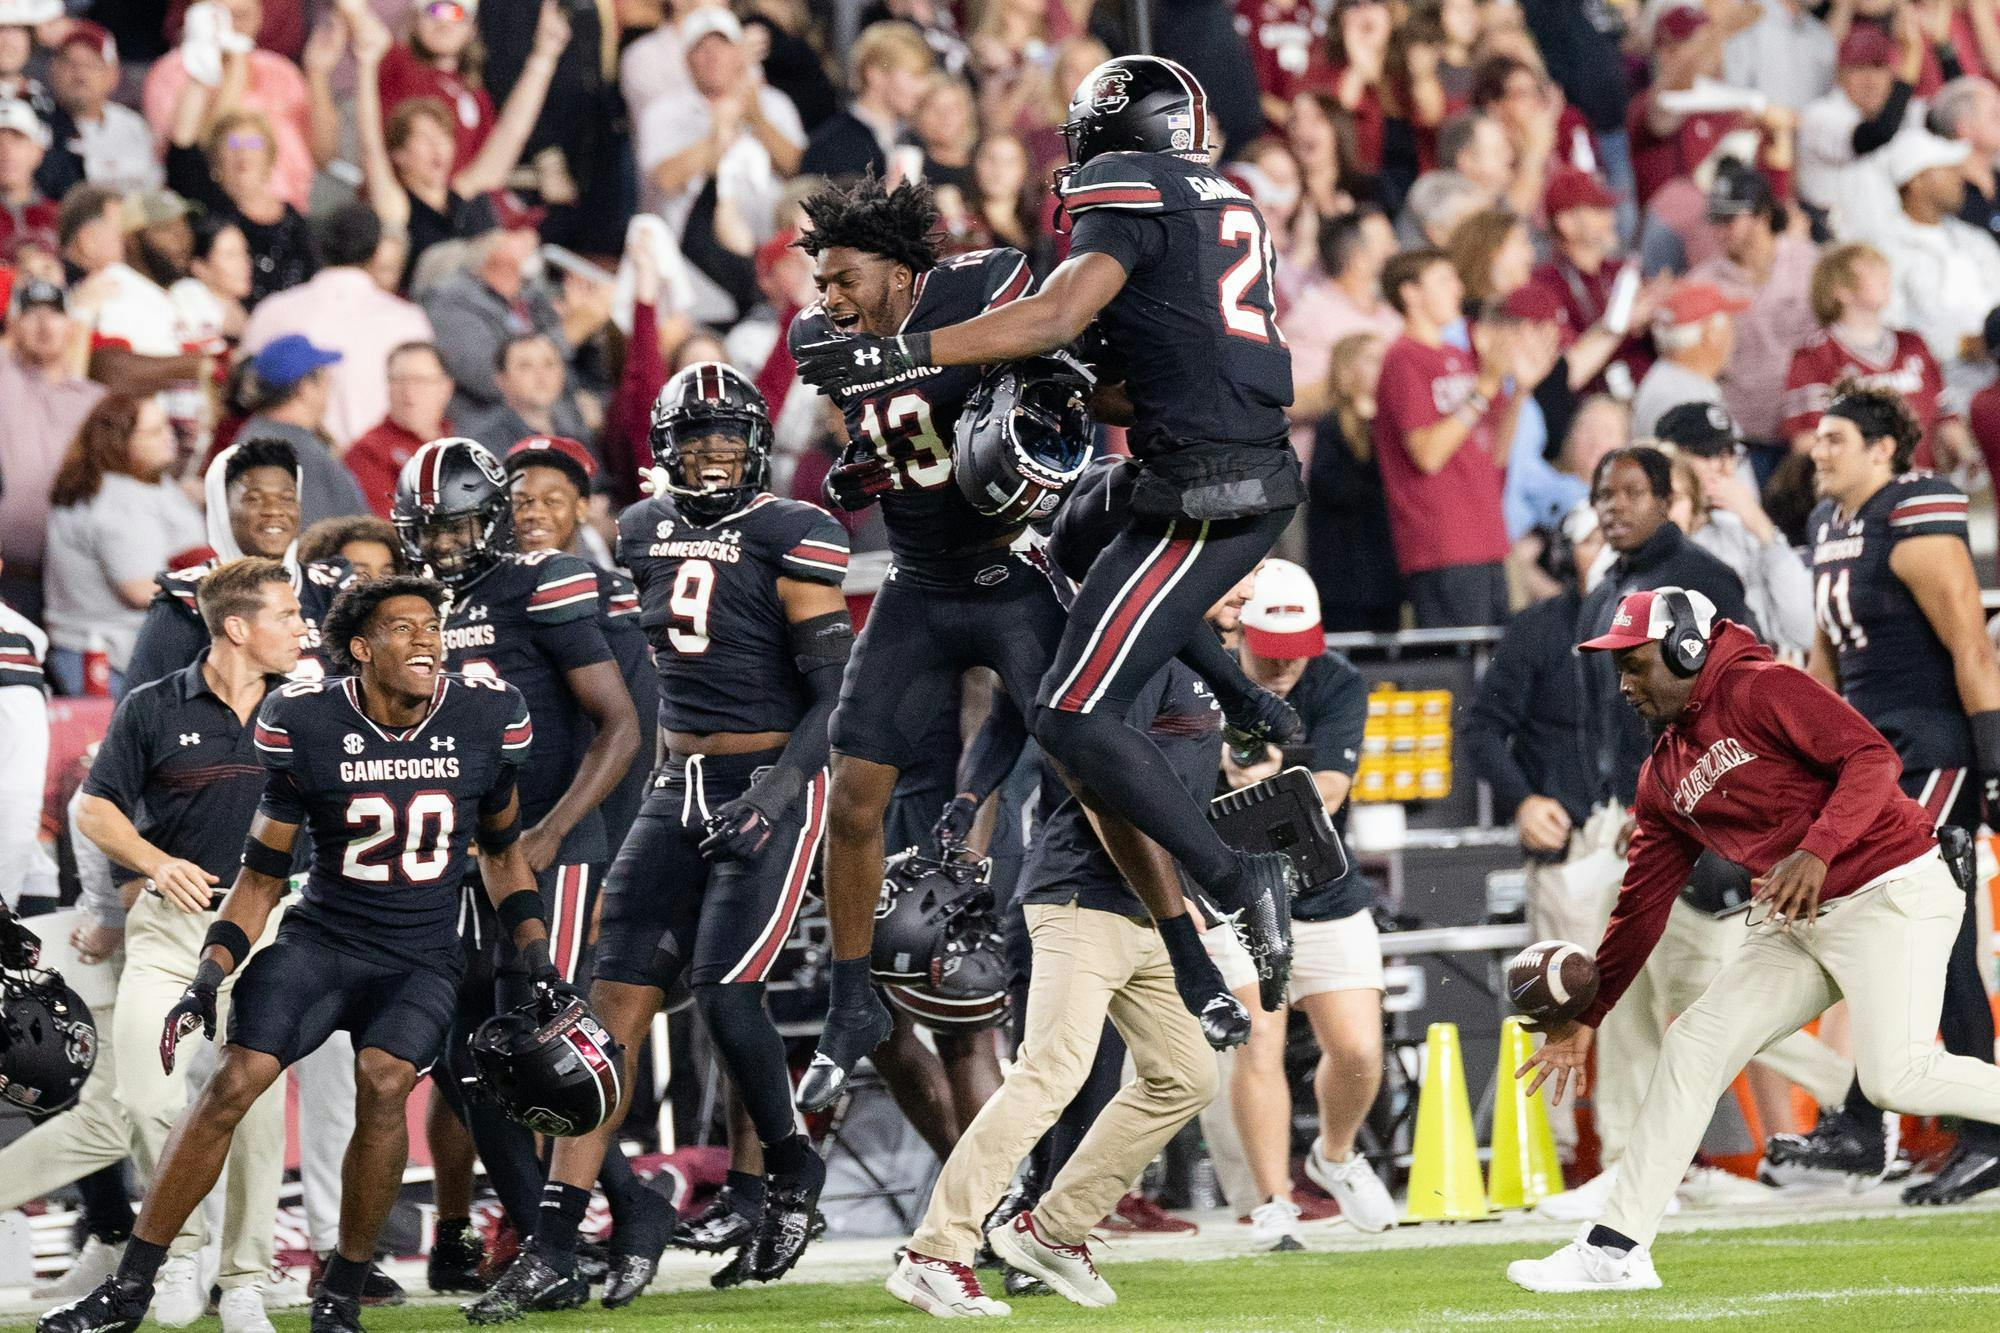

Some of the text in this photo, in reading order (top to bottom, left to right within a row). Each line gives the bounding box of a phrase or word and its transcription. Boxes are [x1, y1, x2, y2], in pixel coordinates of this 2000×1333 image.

[859, 392, 951, 490] 13
[648, 540, 742, 563] GAMECOCKS
[667, 558, 716, 656] 9
[440, 624, 496, 650] ECOCKS
[342, 732, 365, 755] SEC
[339, 756, 461, 783] GAMECOCKS
[1673, 737, 1759, 813] CARLINA
[342, 789, 455, 883] 20
